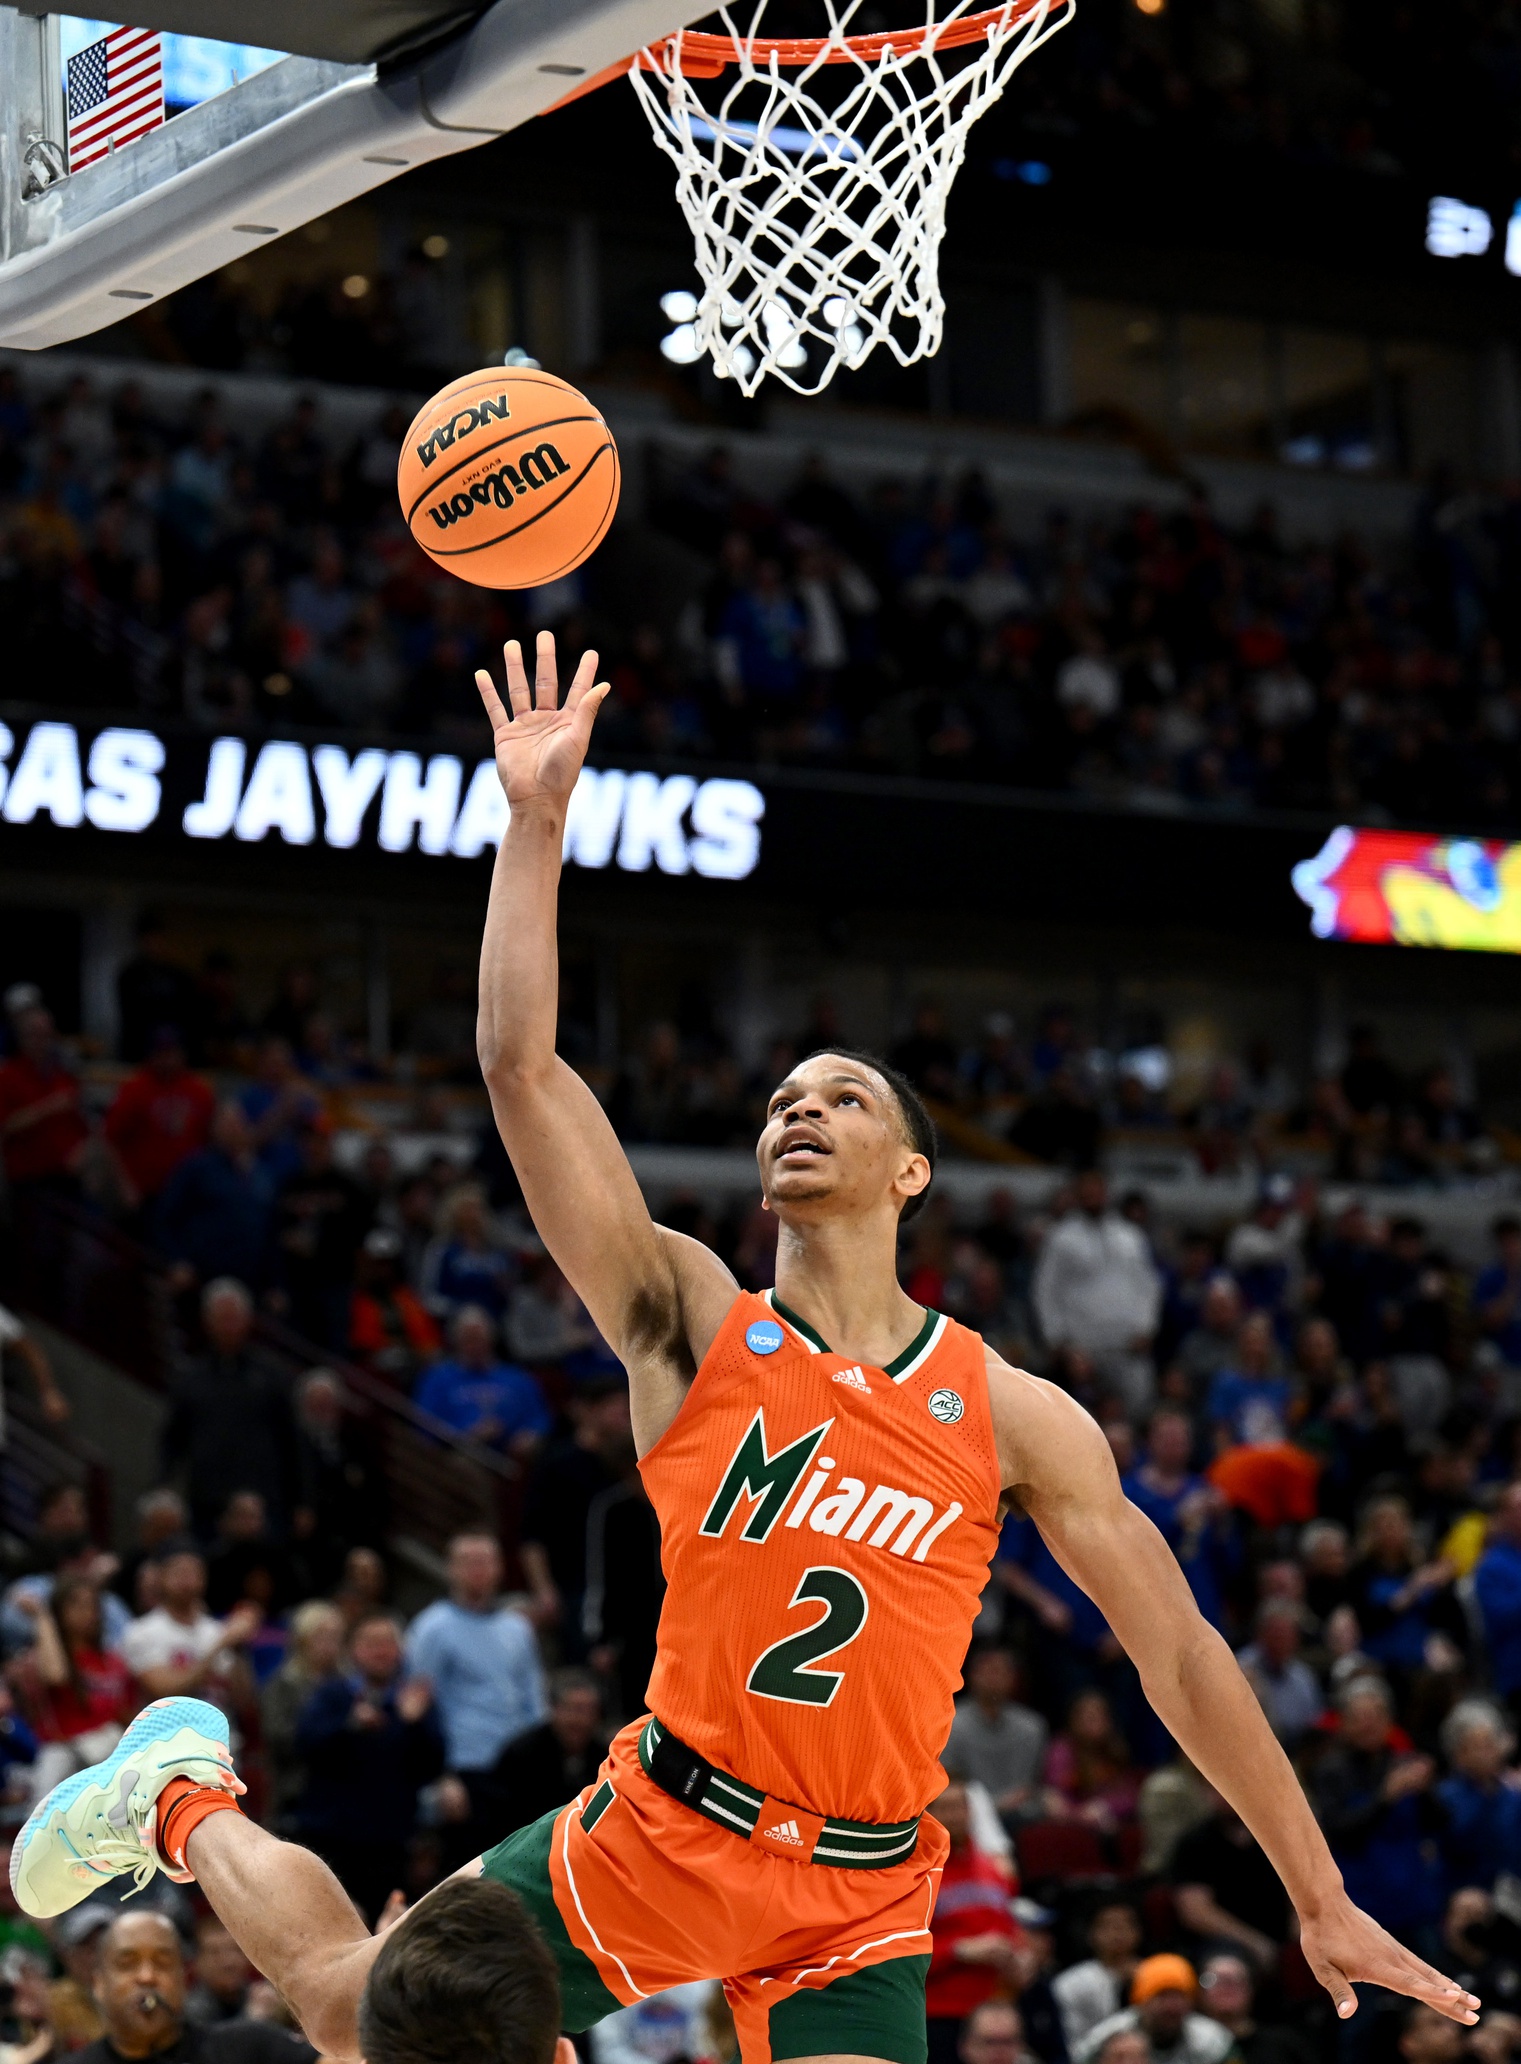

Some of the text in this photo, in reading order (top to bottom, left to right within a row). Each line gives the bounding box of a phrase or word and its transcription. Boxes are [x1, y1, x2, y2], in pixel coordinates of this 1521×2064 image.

[417, 395, 510, 468] NCAA
[428, 443, 571, 529] Wilson
[481, 458, 502, 474] EVO
[0, 720, 166, 833] AS
[750, 1334, 780, 1347] NCAA
[832, 1373, 871, 1394] adidas
[936, 1399, 960, 1411] ACC
[698, 1405, 964, 1563] Miami
[745, 1565, 869, 1708] 2
[764, 1830, 803, 1846] adidas
